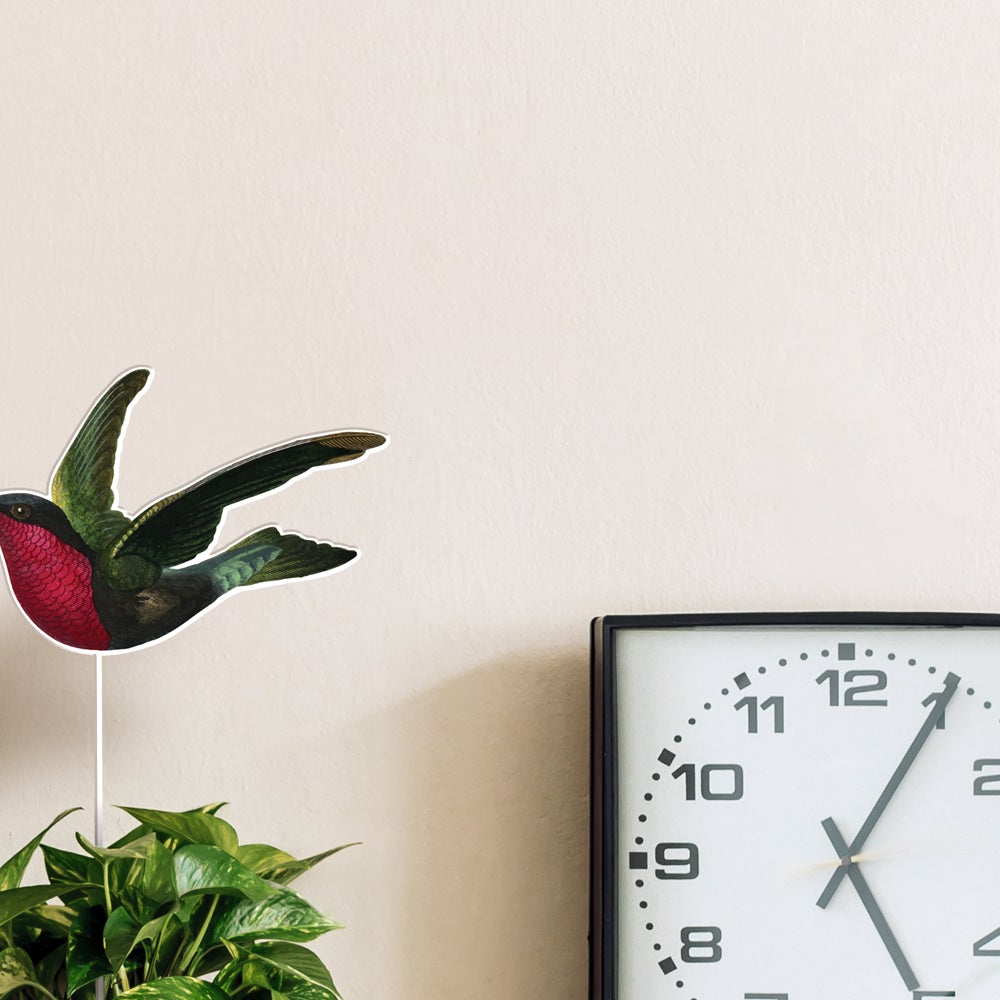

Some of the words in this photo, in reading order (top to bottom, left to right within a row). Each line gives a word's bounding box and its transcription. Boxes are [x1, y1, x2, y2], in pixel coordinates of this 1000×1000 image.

[815, 669, 888, 707] 12
[733, 695, 785, 734] 11
[671, 763, 744, 801] 10
[972, 758, 1000, 796] 2
[654, 842, 700, 881] 9
[679, 925, 723, 964] 8
